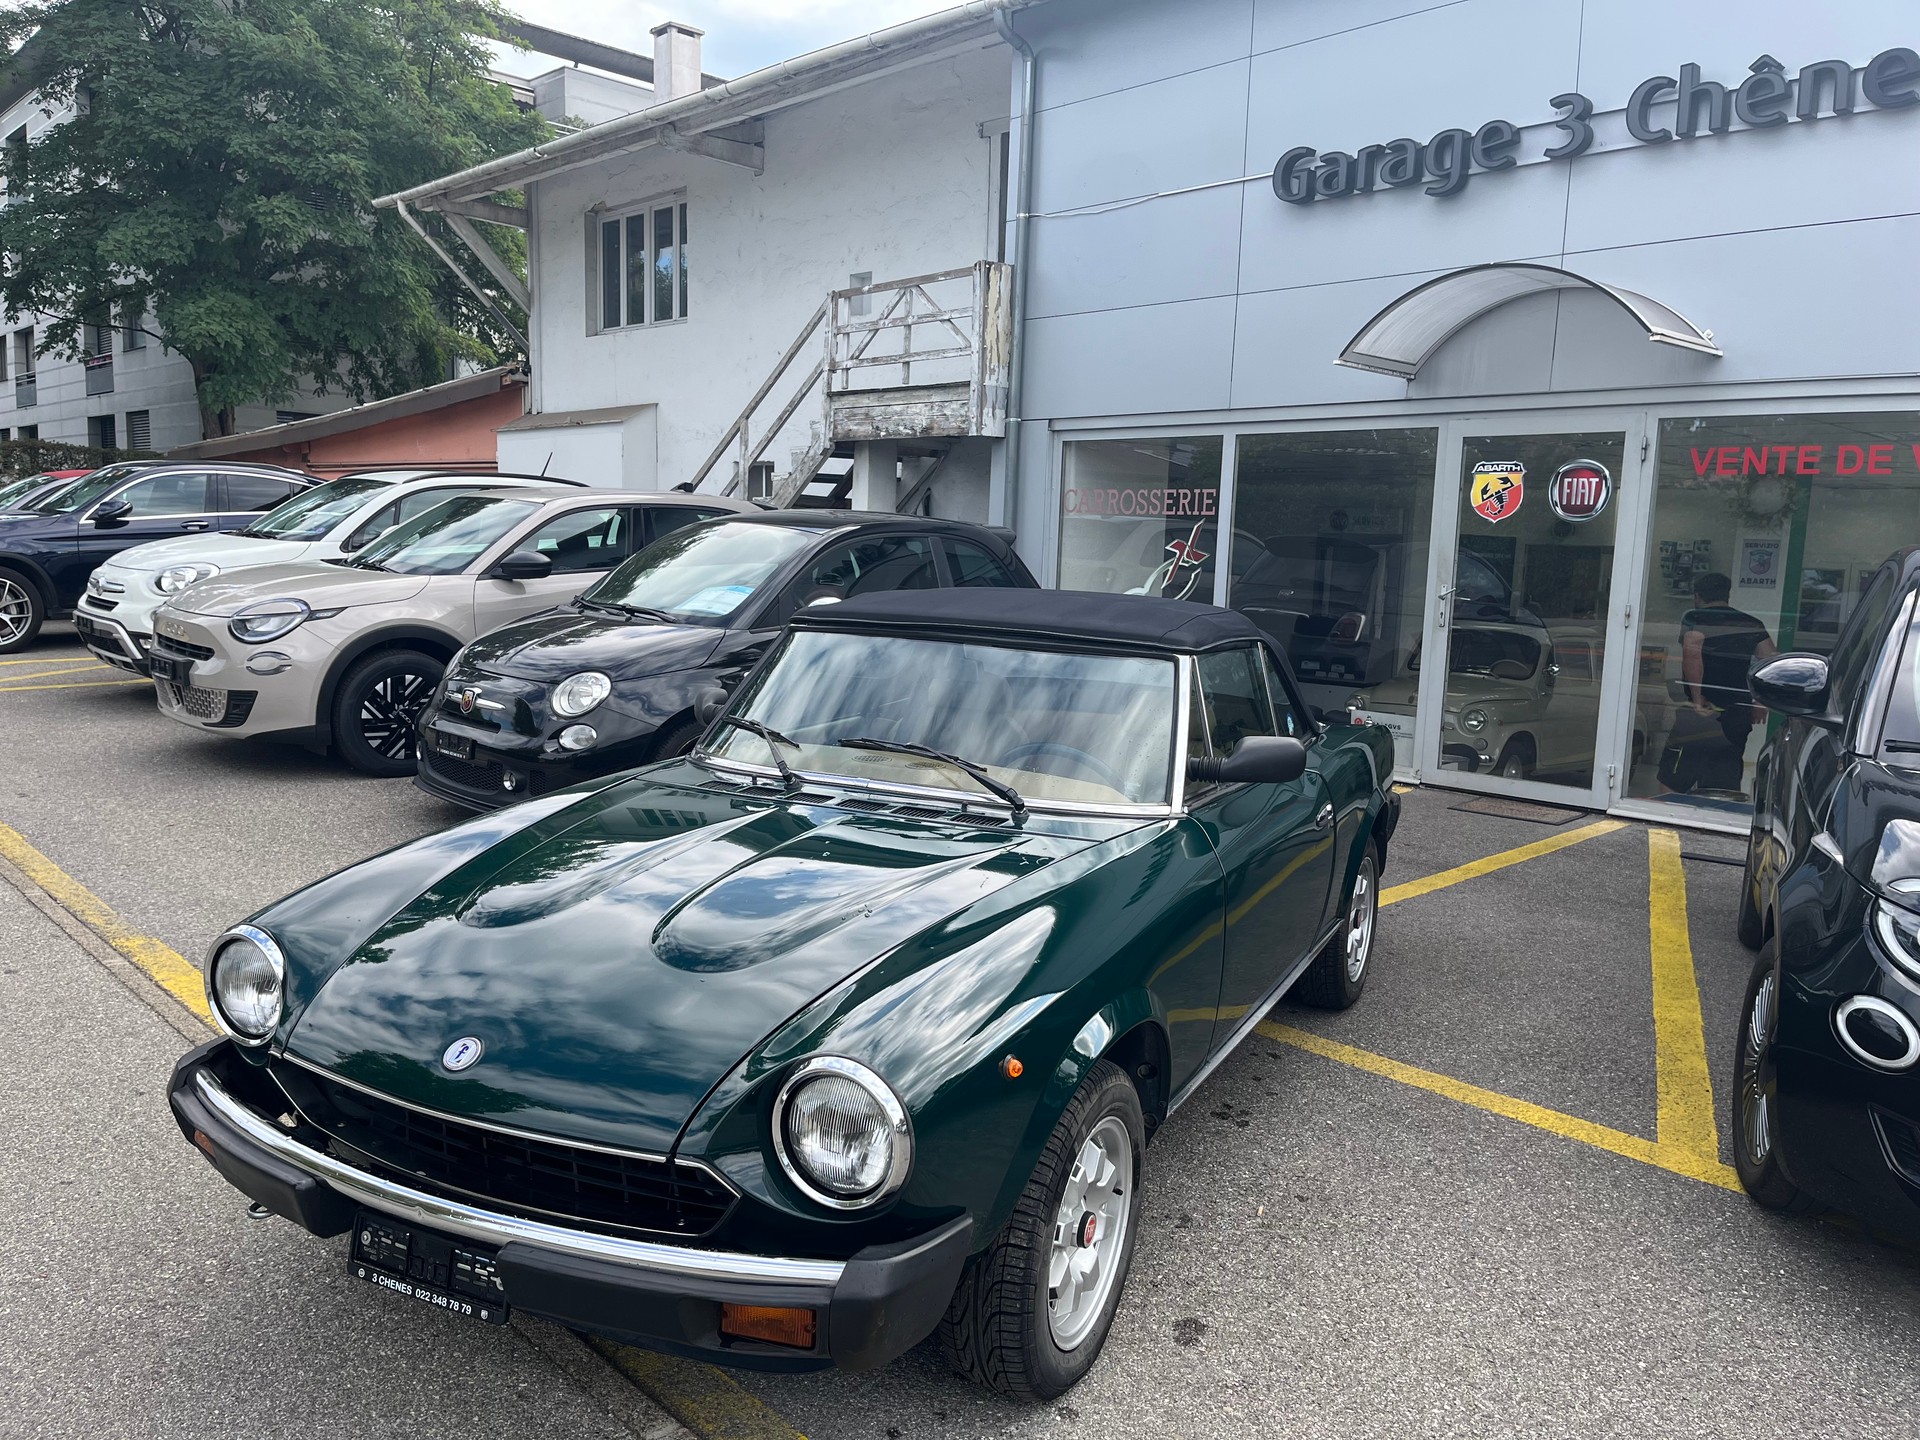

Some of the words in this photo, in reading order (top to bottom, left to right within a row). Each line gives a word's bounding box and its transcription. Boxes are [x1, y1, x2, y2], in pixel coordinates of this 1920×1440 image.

[1273, 119, 1520, 204] Garage
[1543, 92, 1593, 160] 3
[1476, 464, 1521, 472] ABARTH
[1690, 445, 1823, 476] VENTE
[1836, 444, 1895, 475] DE
[1064, 488, 1217, 516] CARROSSERIE
[1561, 477, 1600, 506] FIAT
[1739, 577, 1777, 585] ABARTH
[372, 1273, 378, 1283] 3
[378, 1275, 413, 1295] CHENES
[415, 1288, 431, 1302] 022
[431, 1293, 448, 1307] 348
[448, 1299, 460, 1311] 78
[460, 1303, 472, 1315] 79
